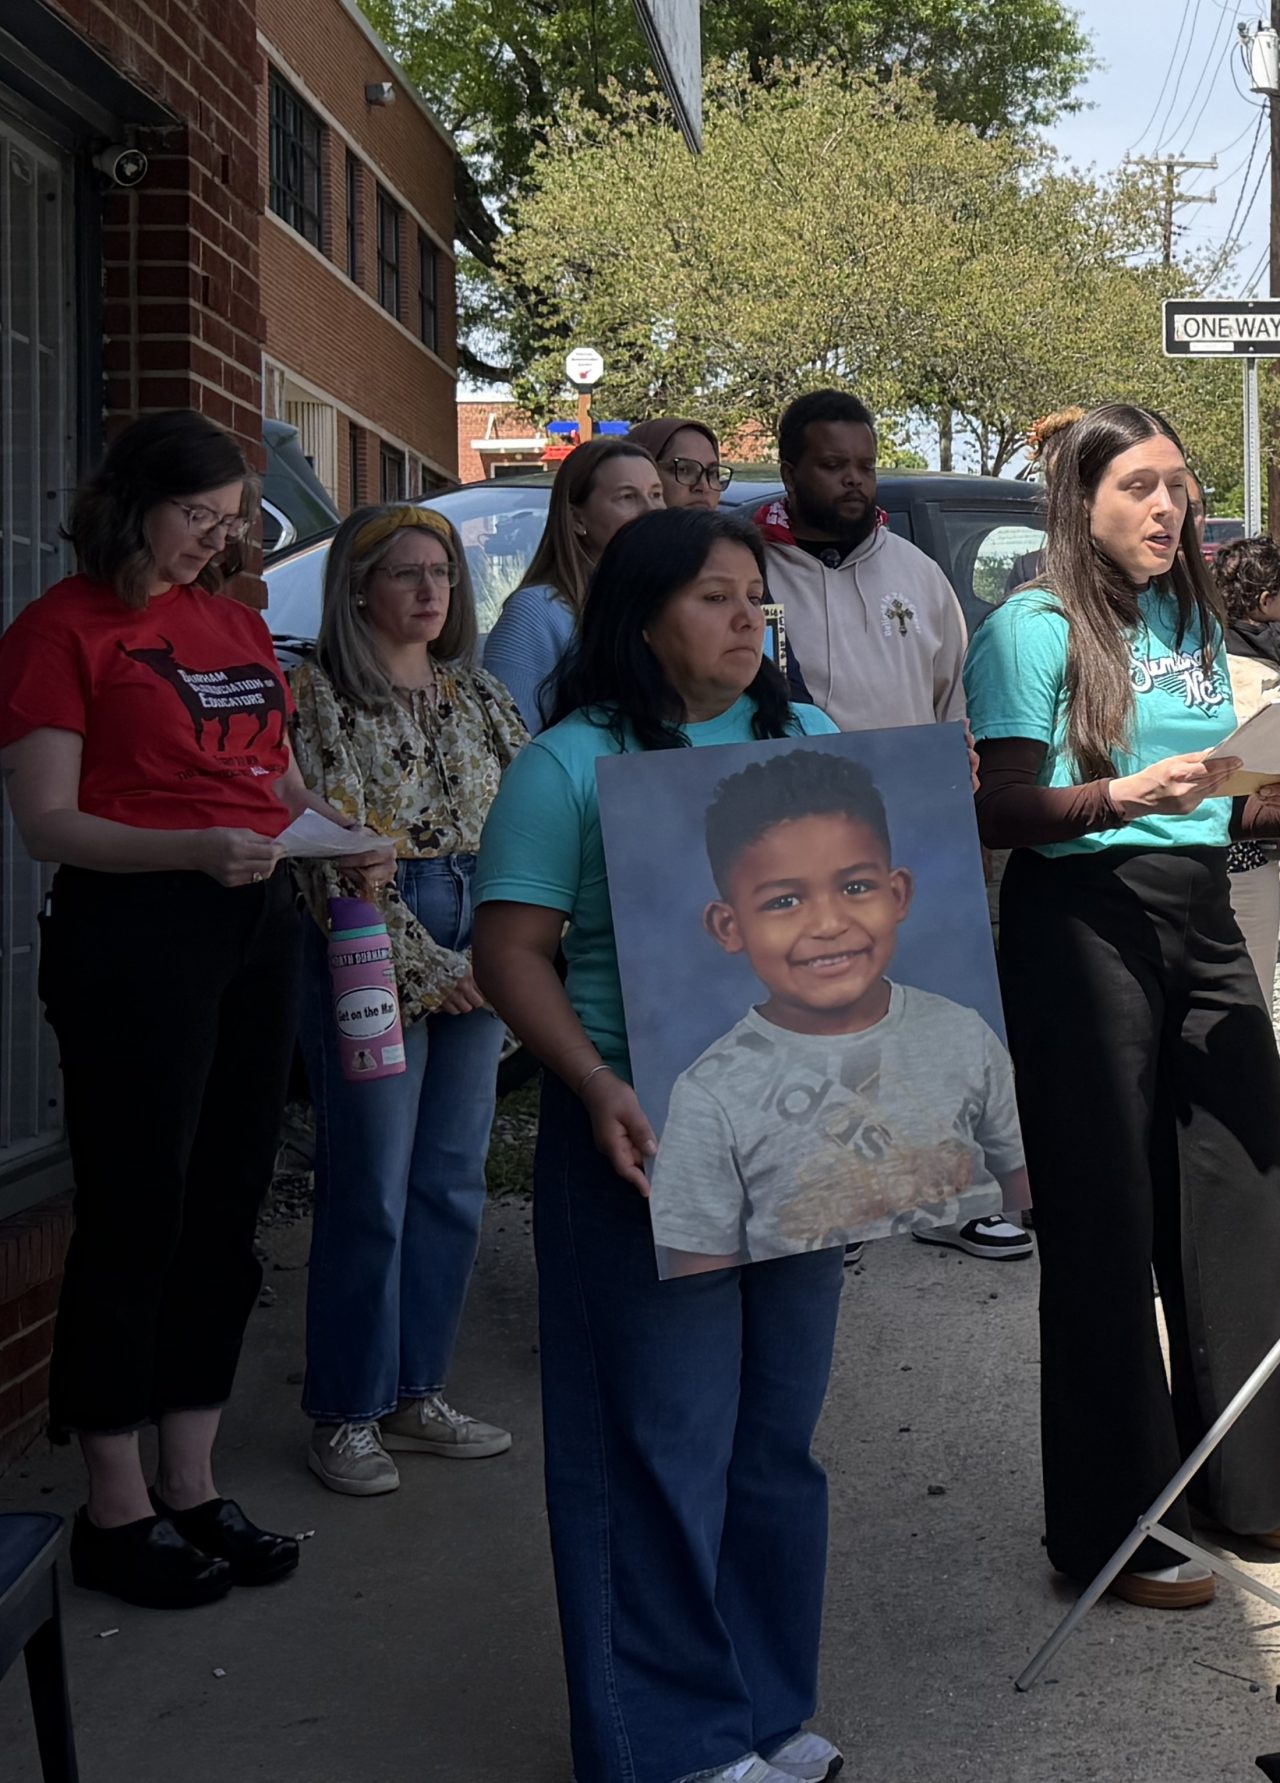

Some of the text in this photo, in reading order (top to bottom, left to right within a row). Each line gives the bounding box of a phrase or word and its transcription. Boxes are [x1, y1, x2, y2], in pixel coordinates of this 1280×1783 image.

[1183, 317, 1231, 339] ONE
[1178, 668, 1223, 707] NC
[198, 692, 266, 708] EDUCATORS
[351, 1010, 363, 1021] on
